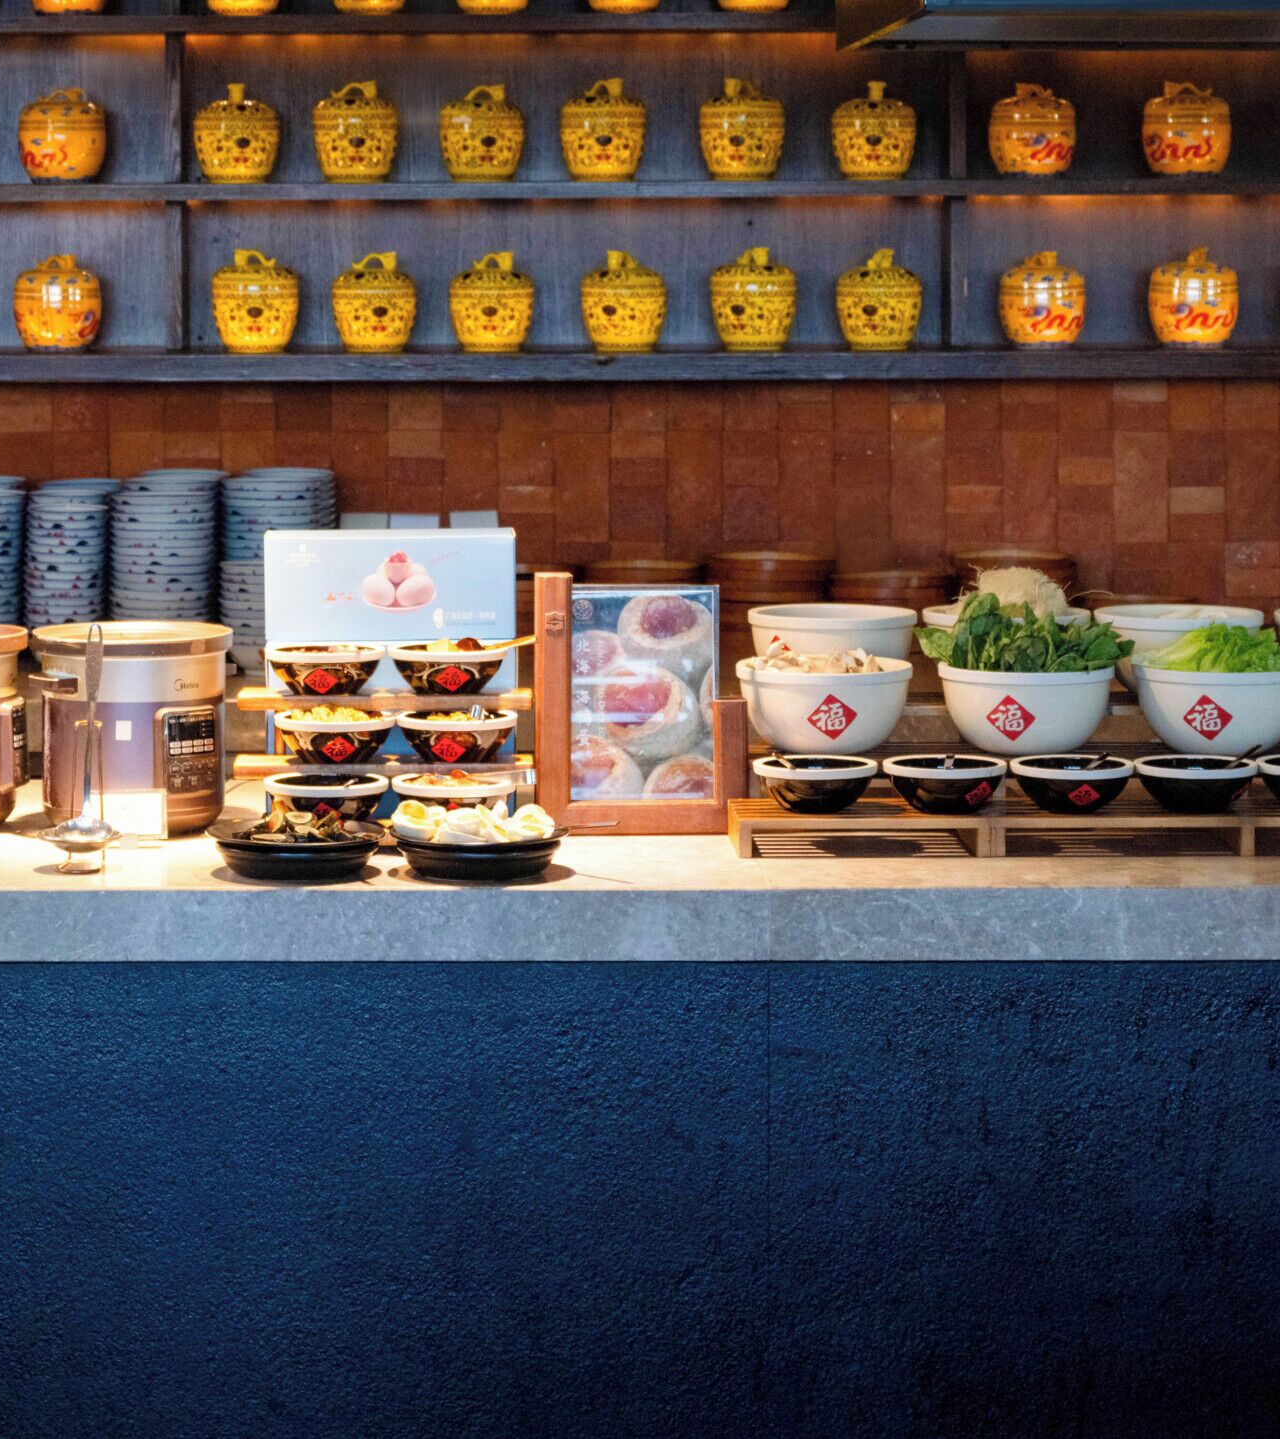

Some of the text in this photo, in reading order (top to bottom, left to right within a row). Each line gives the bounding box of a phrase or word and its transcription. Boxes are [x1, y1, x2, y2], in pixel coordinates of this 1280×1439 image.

[576, 639, 591, 673] 北海
[309, 674, 330, 689] 福
[439, 672, 462, 687] 福
[811, 702, 846, 731] 福
[990, 703, 1025, 732] 福
[1186, 703, 1222, 732] 福
[436, 743, 458, 757] 福
